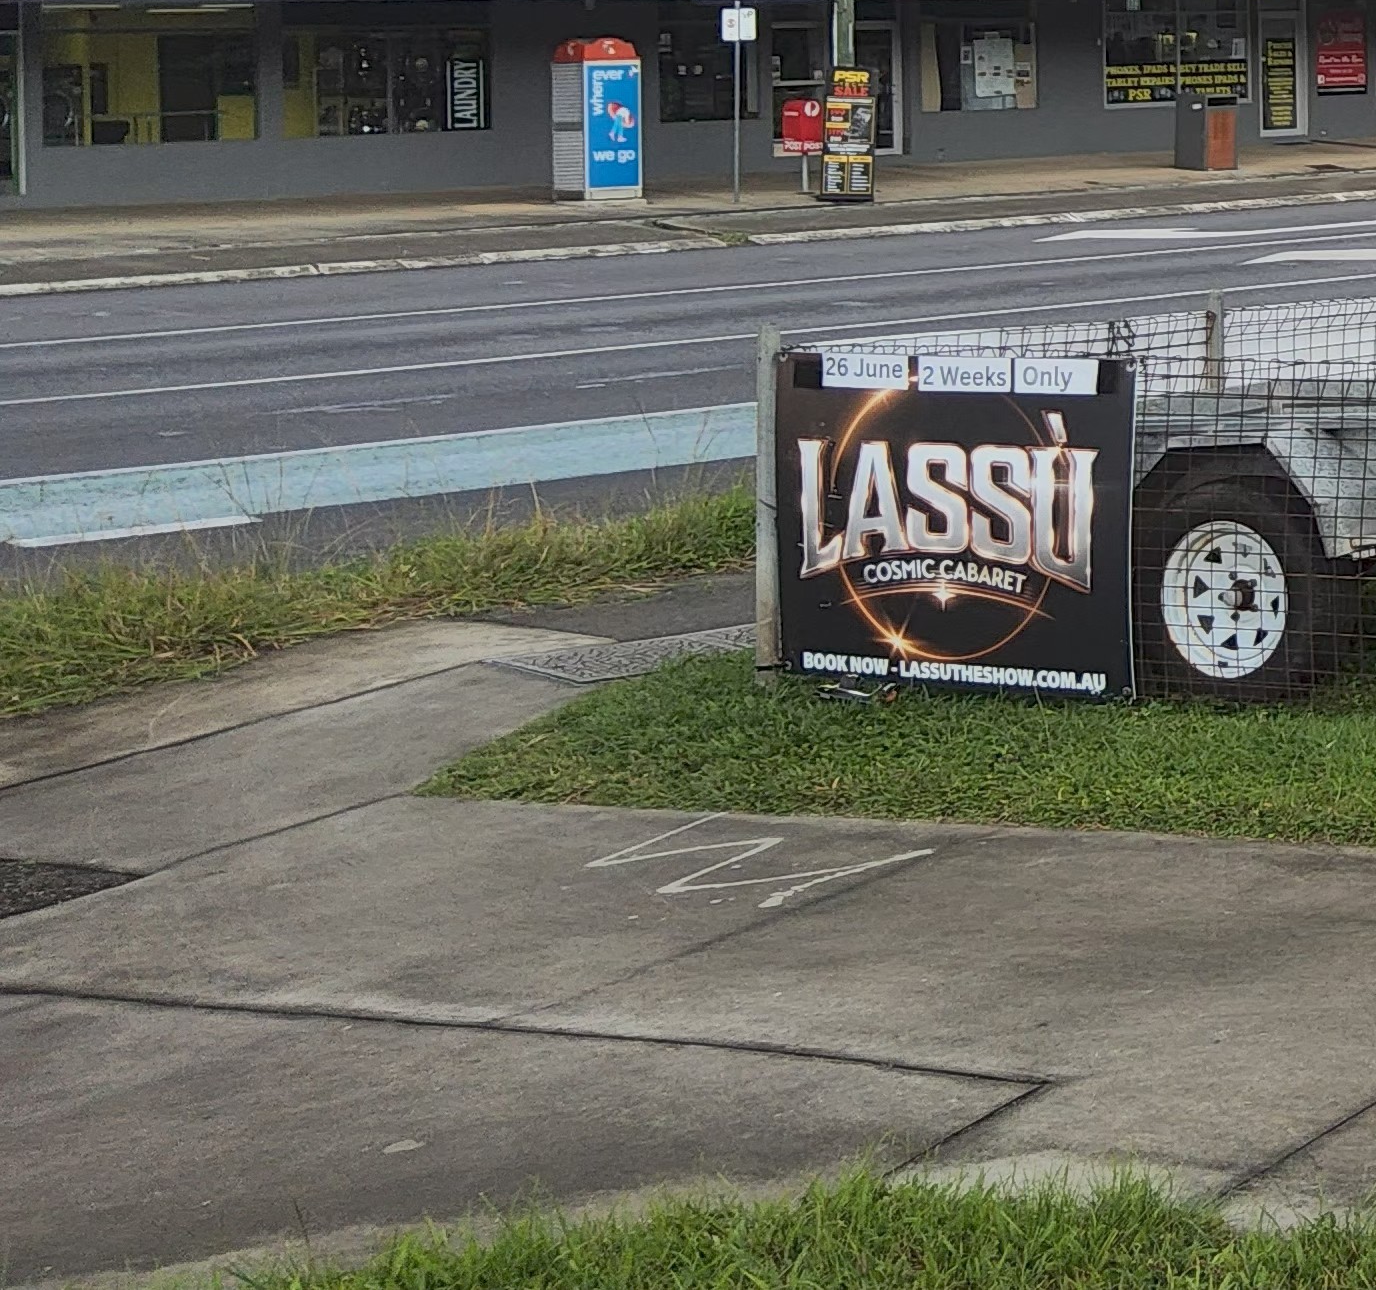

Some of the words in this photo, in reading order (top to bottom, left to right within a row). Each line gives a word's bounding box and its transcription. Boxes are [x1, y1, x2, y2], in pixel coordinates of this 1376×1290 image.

[833, 70, 870, 83] PSR
[453, 60, 478, 129] LAUNDRY
[833, 86, 869, 97] SALE
[1128, 88, 1152, 101] PSR
[592, 150, 615, 162] we
[617, 149, 636, 164] go
[784, 140, 803, 151] POST
[825, 357, 850, 379] 26
[853, 357, 904, 380] June
[922, 367, 936, 387] 2
[938, 366, 1008, 388] Weeks
[1022, 367, 1073, 393] Only
[797, 410, 1100, 595] LASSÙ
[863, 559, 937, 585] COSMIC
[938, 559, 1028, 595] CABARET
[802, 651, 849, 673] BOOK
[849, 655, 889, 676] NOW
[899, 660, 1107, 693] LASSUTHESHOW.COM.AU
